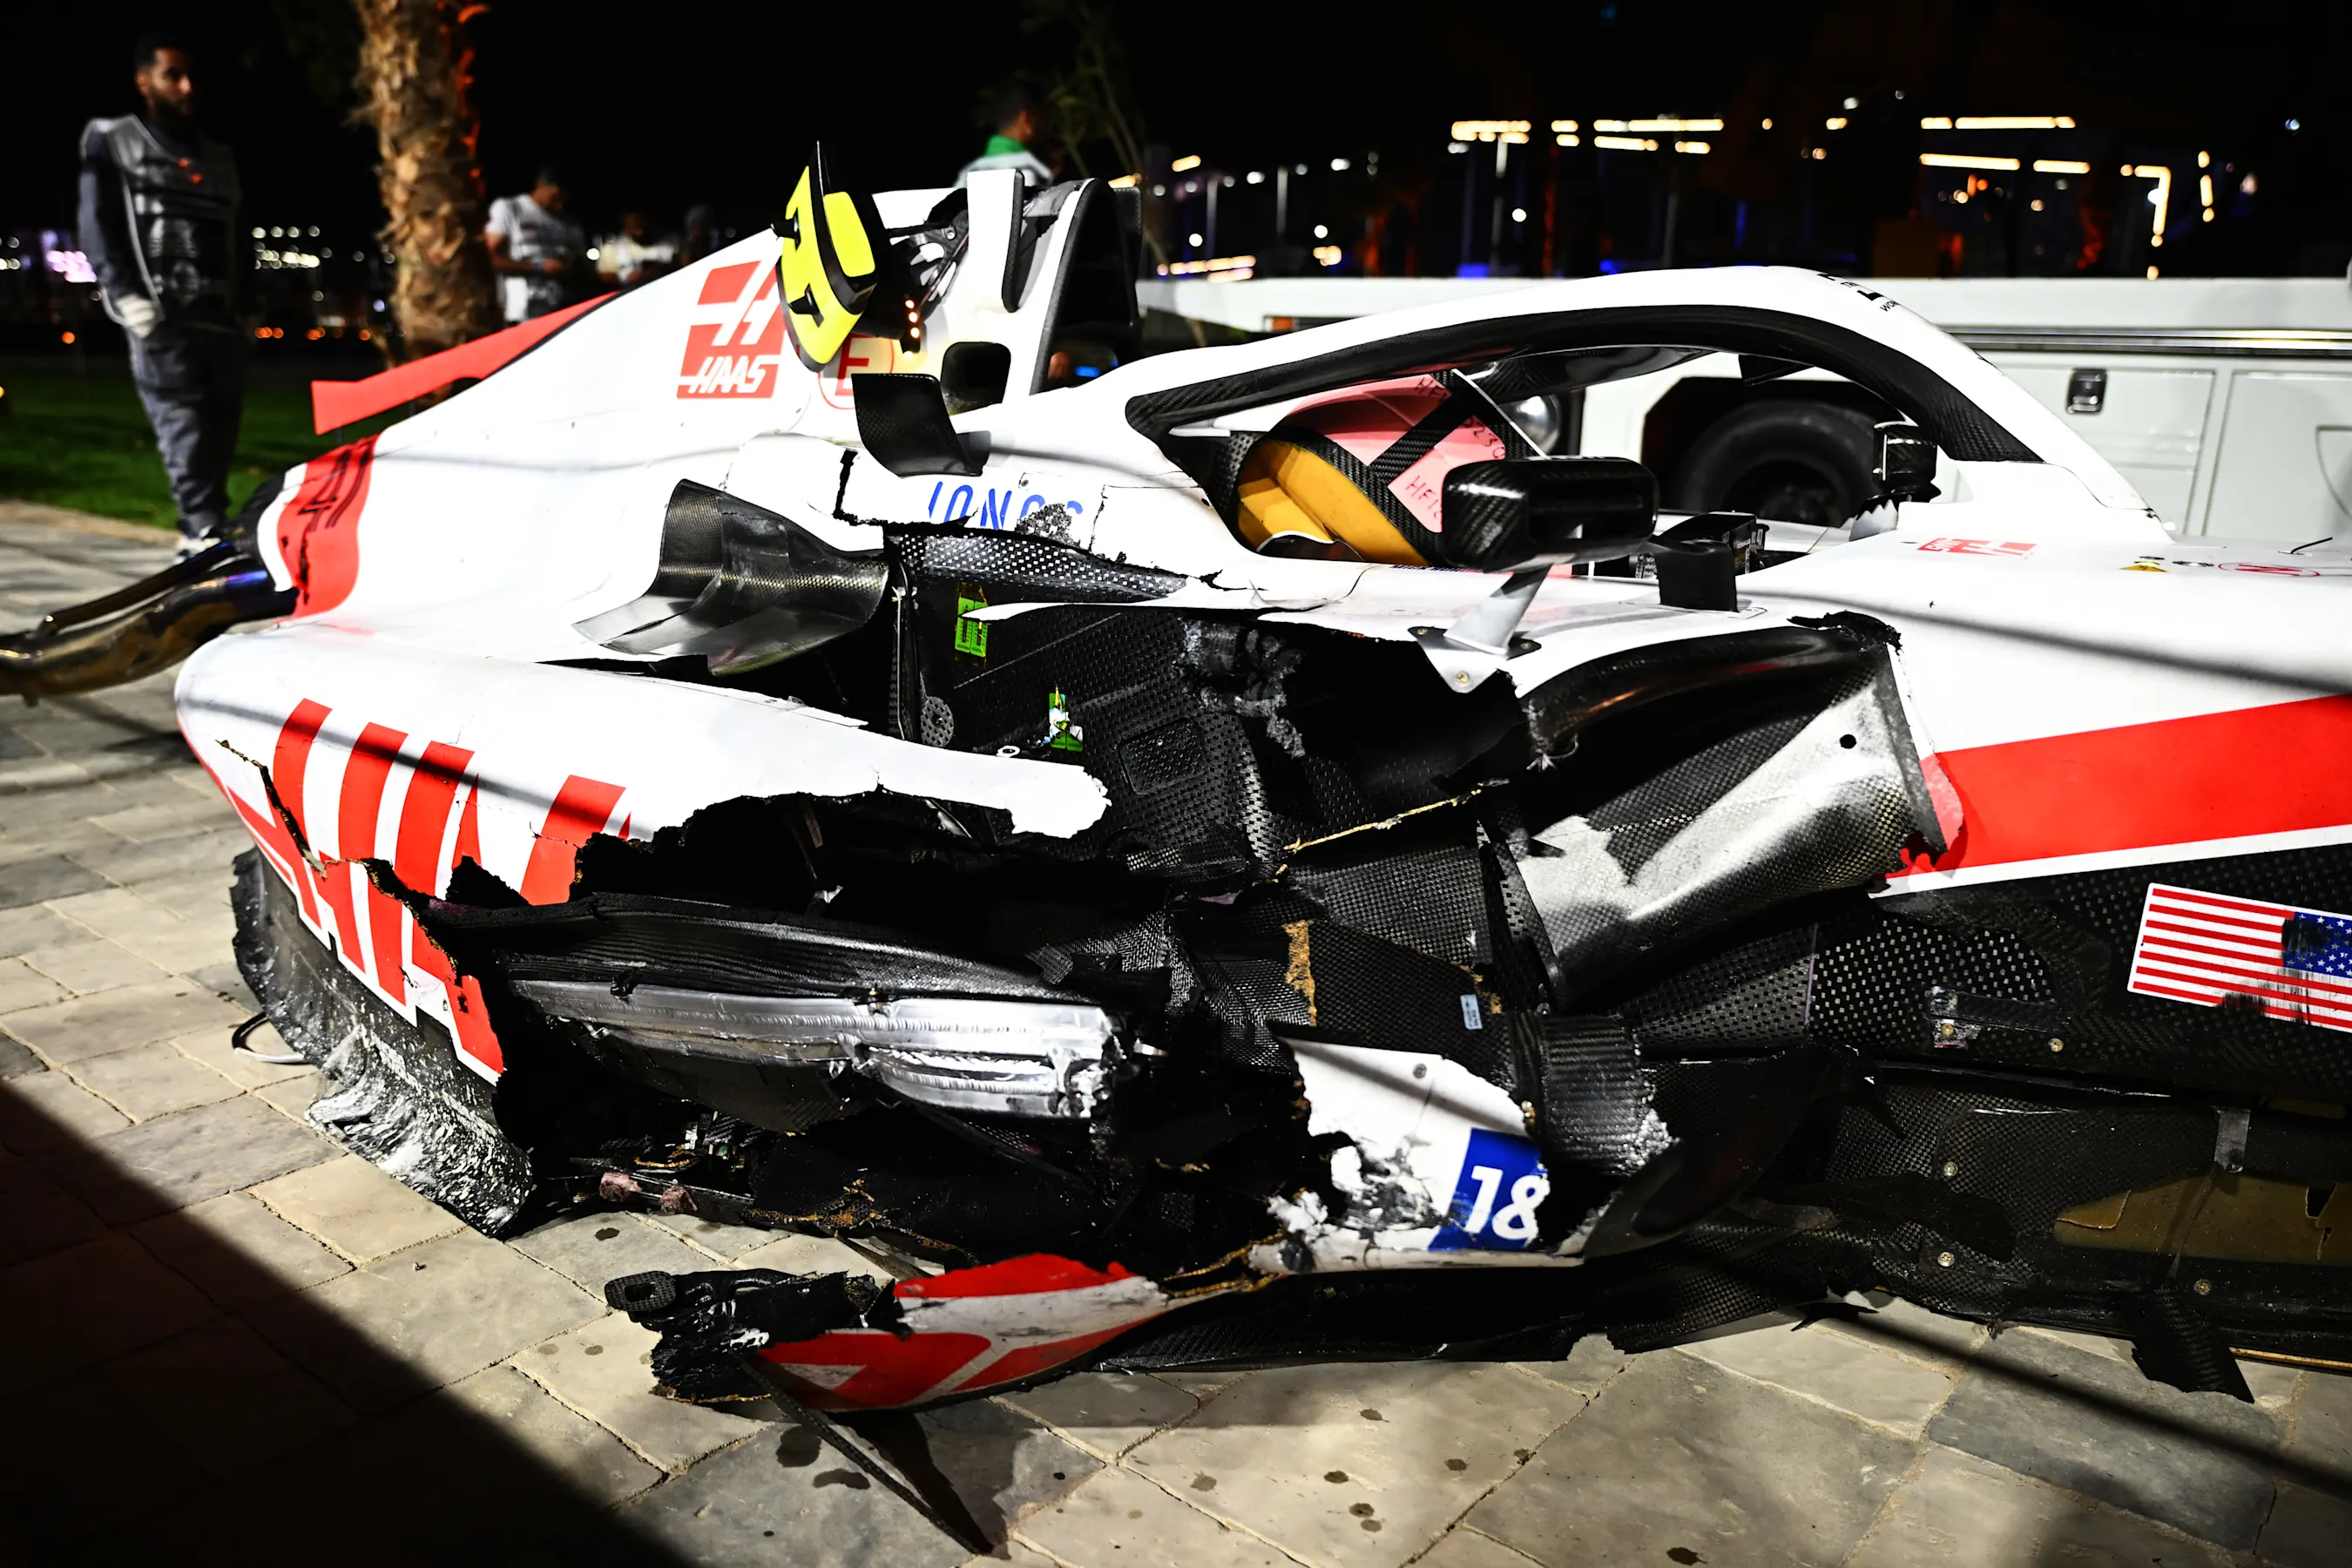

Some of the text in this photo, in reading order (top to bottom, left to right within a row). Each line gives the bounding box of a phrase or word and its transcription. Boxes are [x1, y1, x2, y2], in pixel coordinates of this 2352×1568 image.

[679, 355, 781, 394] HAAS
[835, 333, 875, 396] E
[928, 481, 1084, 531] IONO
